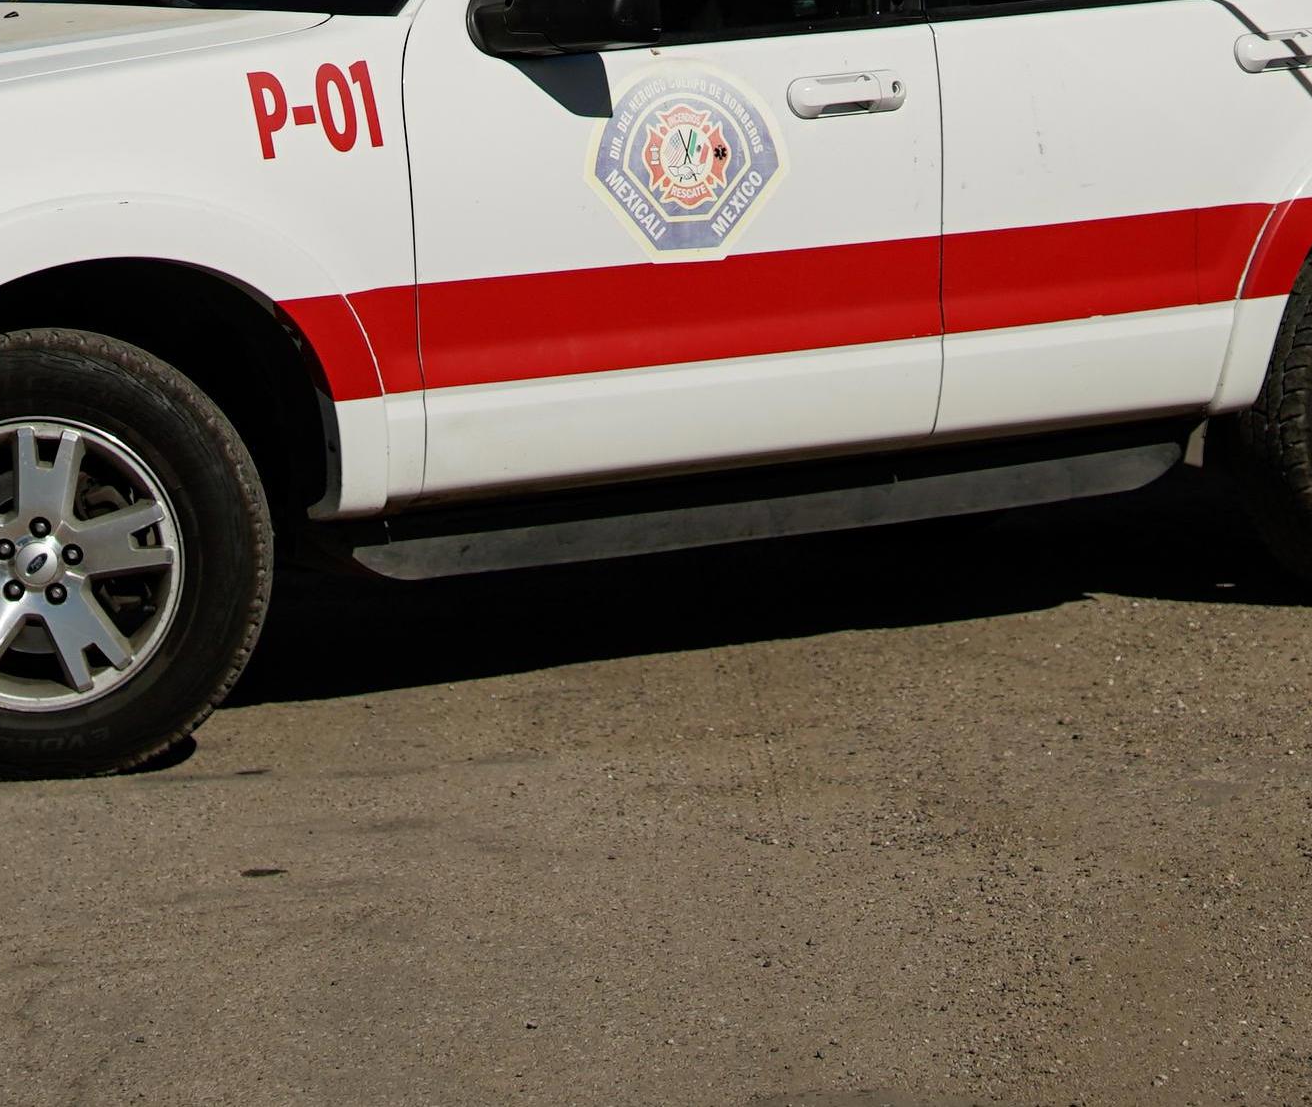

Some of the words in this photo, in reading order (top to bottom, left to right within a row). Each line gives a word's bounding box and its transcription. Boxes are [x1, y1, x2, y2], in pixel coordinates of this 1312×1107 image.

[708, 83, 722, 99] DE
[246, 60, 385, 160] P-01
[616, 114, 633, 134] DEL
[722, 94, 764, 155] BOMBEROS
[610, 135, 625, 160] DIR.
[671, 185, 708, 198] RESCATE
[605, 170, 667, 241] MEXICALI
